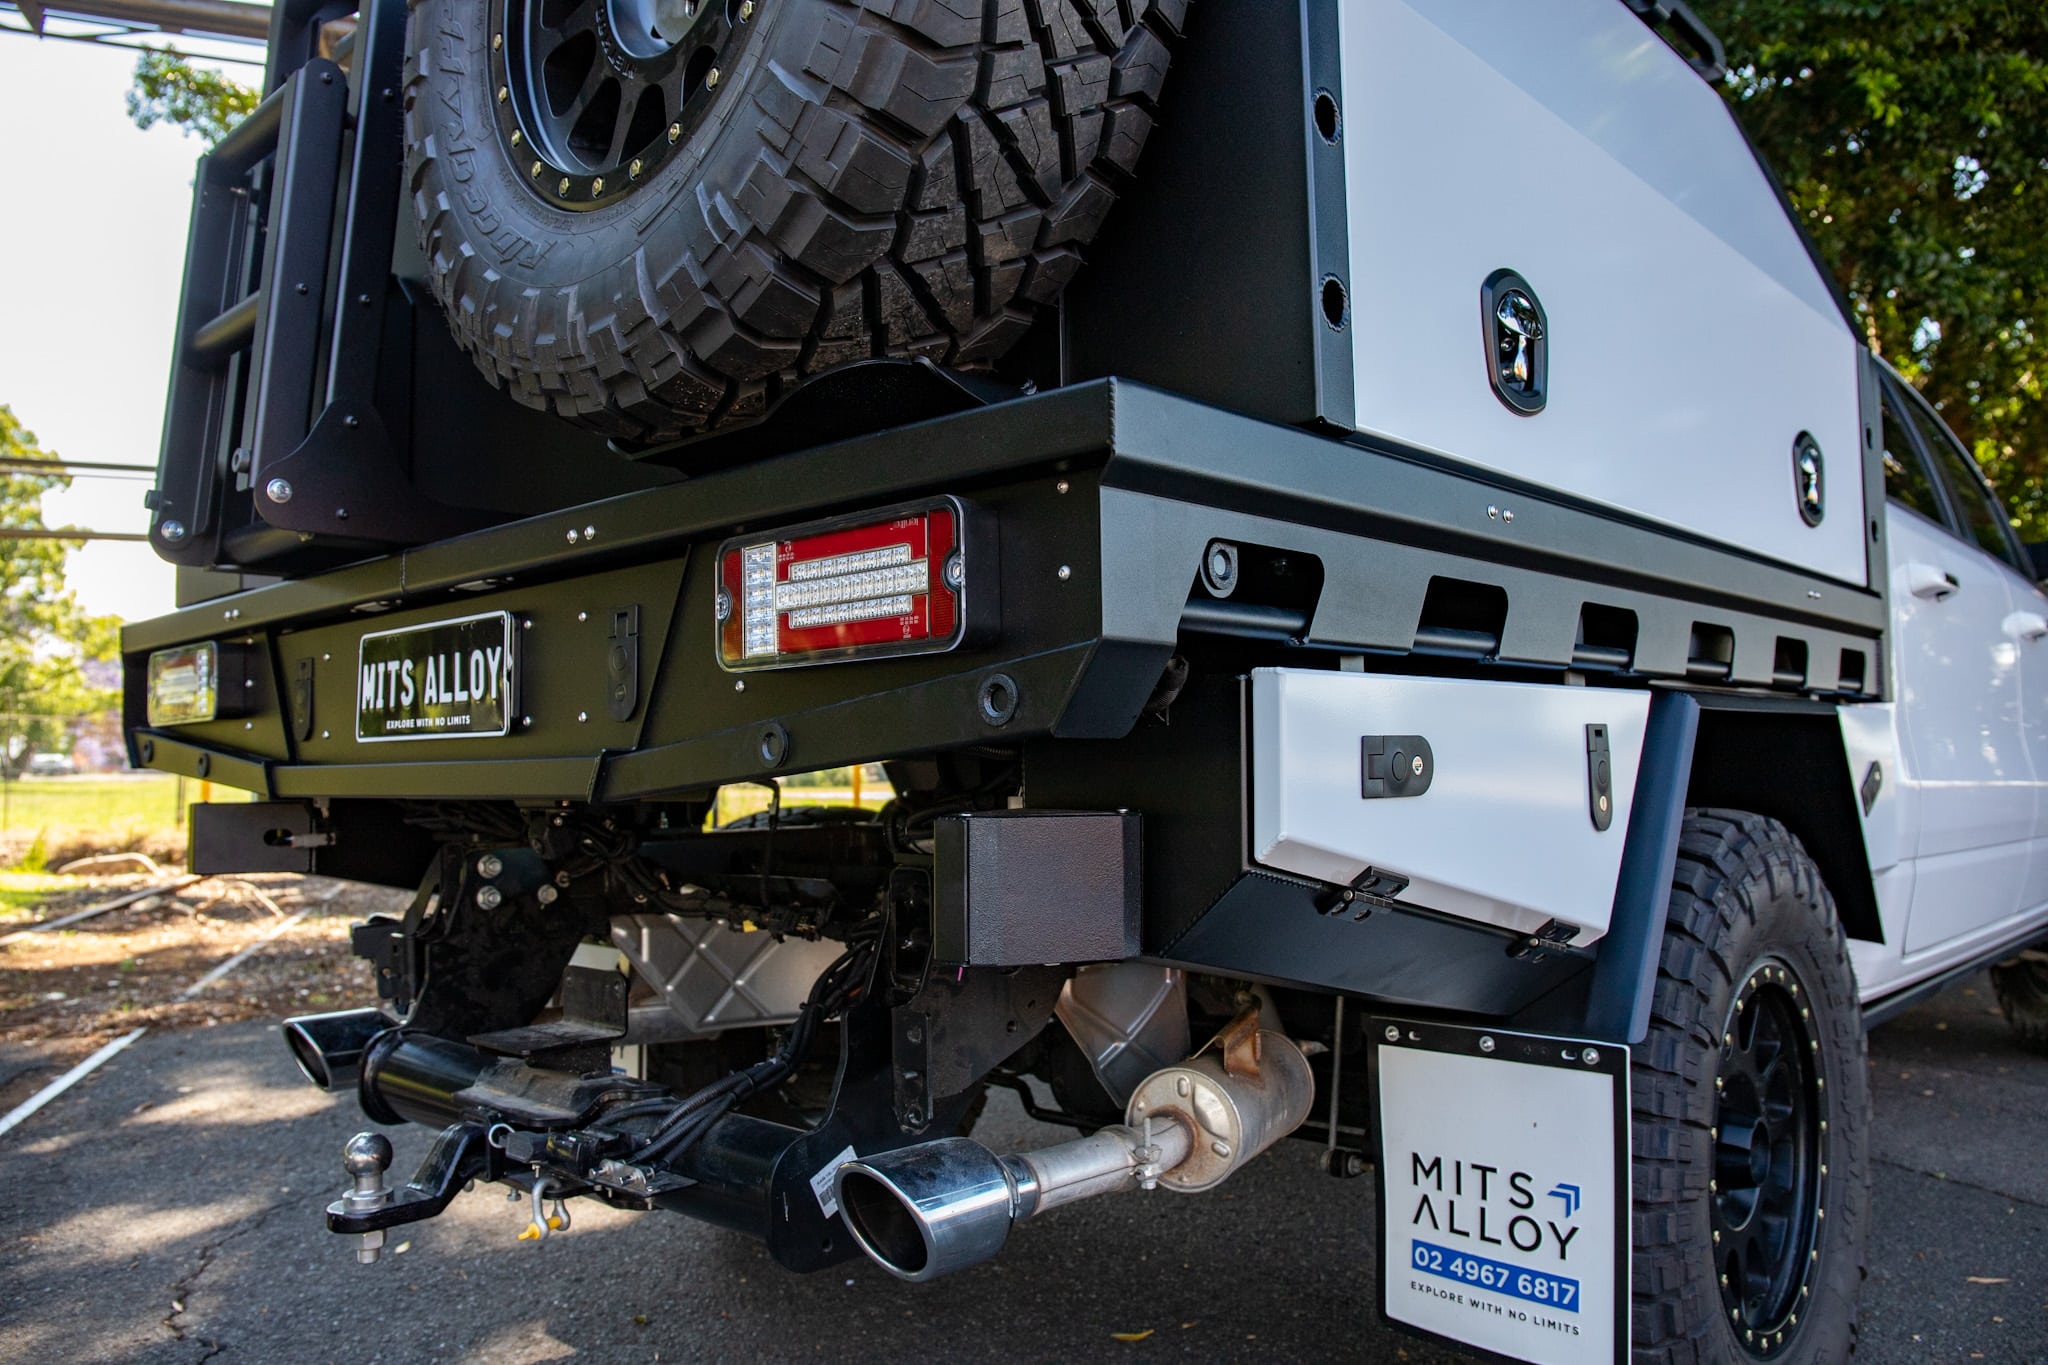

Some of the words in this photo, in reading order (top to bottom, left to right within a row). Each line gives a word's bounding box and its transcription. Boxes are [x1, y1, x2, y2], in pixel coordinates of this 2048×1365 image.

[362, 659, 415, 711] MITS
[424, 646, 502, 705] ALLOY
[386, 718, 415, 730] EXPLORE
[416, 716, 433, 727] WITH
[435, 716, 445, 726] NO
[447, 715, 471, 726] LIMITS
[1411, 1151, 1535, 1210] MITS
[1412, 1193, 1580, 1261] ALLOY
[1414, 1247, 1443, 1272] 02
[1449, 1257, 1510, 1289] 4967
[1517, 1273, 1577, 1306] 6817
[1411, 1281, 1464, 1305] EXPLORE
[1469, 1298, 1502, 1315] WITH
[1508, 1309, 1527, 1322] NO
[1534, 1316, 1580, 1336] LIMITS
